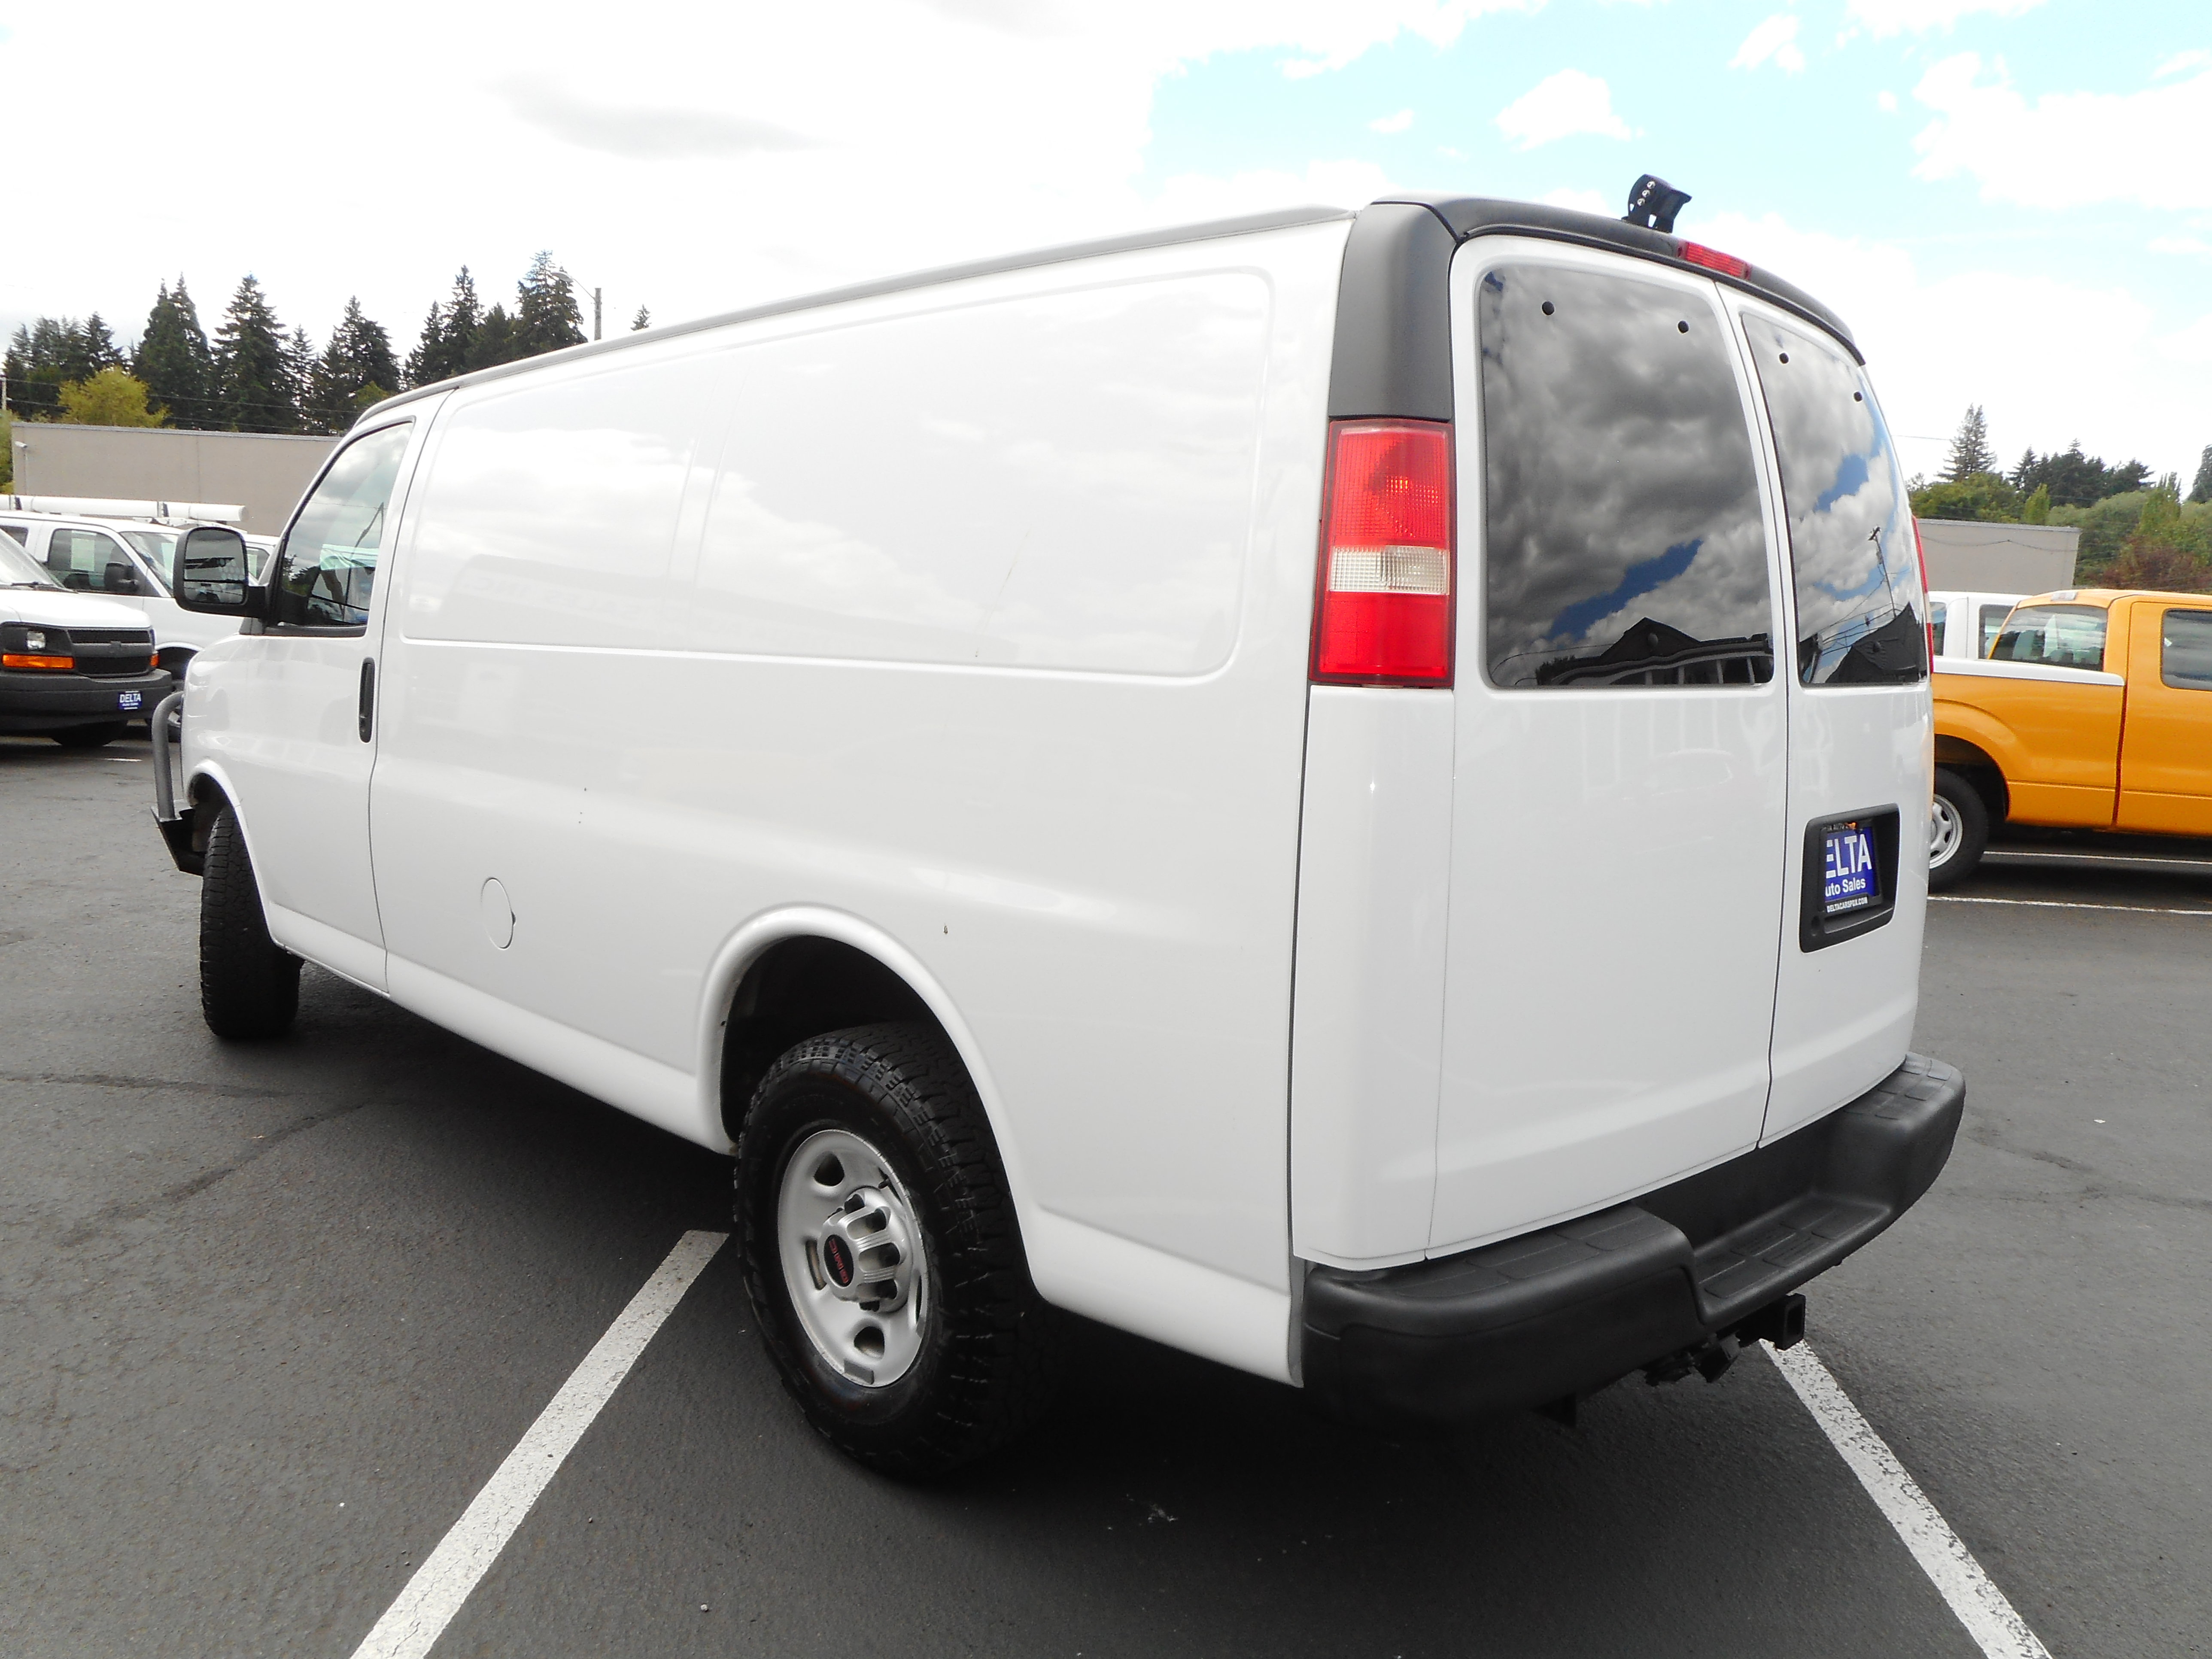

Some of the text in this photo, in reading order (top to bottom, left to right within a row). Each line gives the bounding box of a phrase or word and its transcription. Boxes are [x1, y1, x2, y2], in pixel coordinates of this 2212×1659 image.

[120, 693, 141, 703] DELTA
[1826, 834, 1872, 879] ELTA
[1825, 877, 1866, 897] uto Sales
[829, 1238, 849, 1283] GMC
